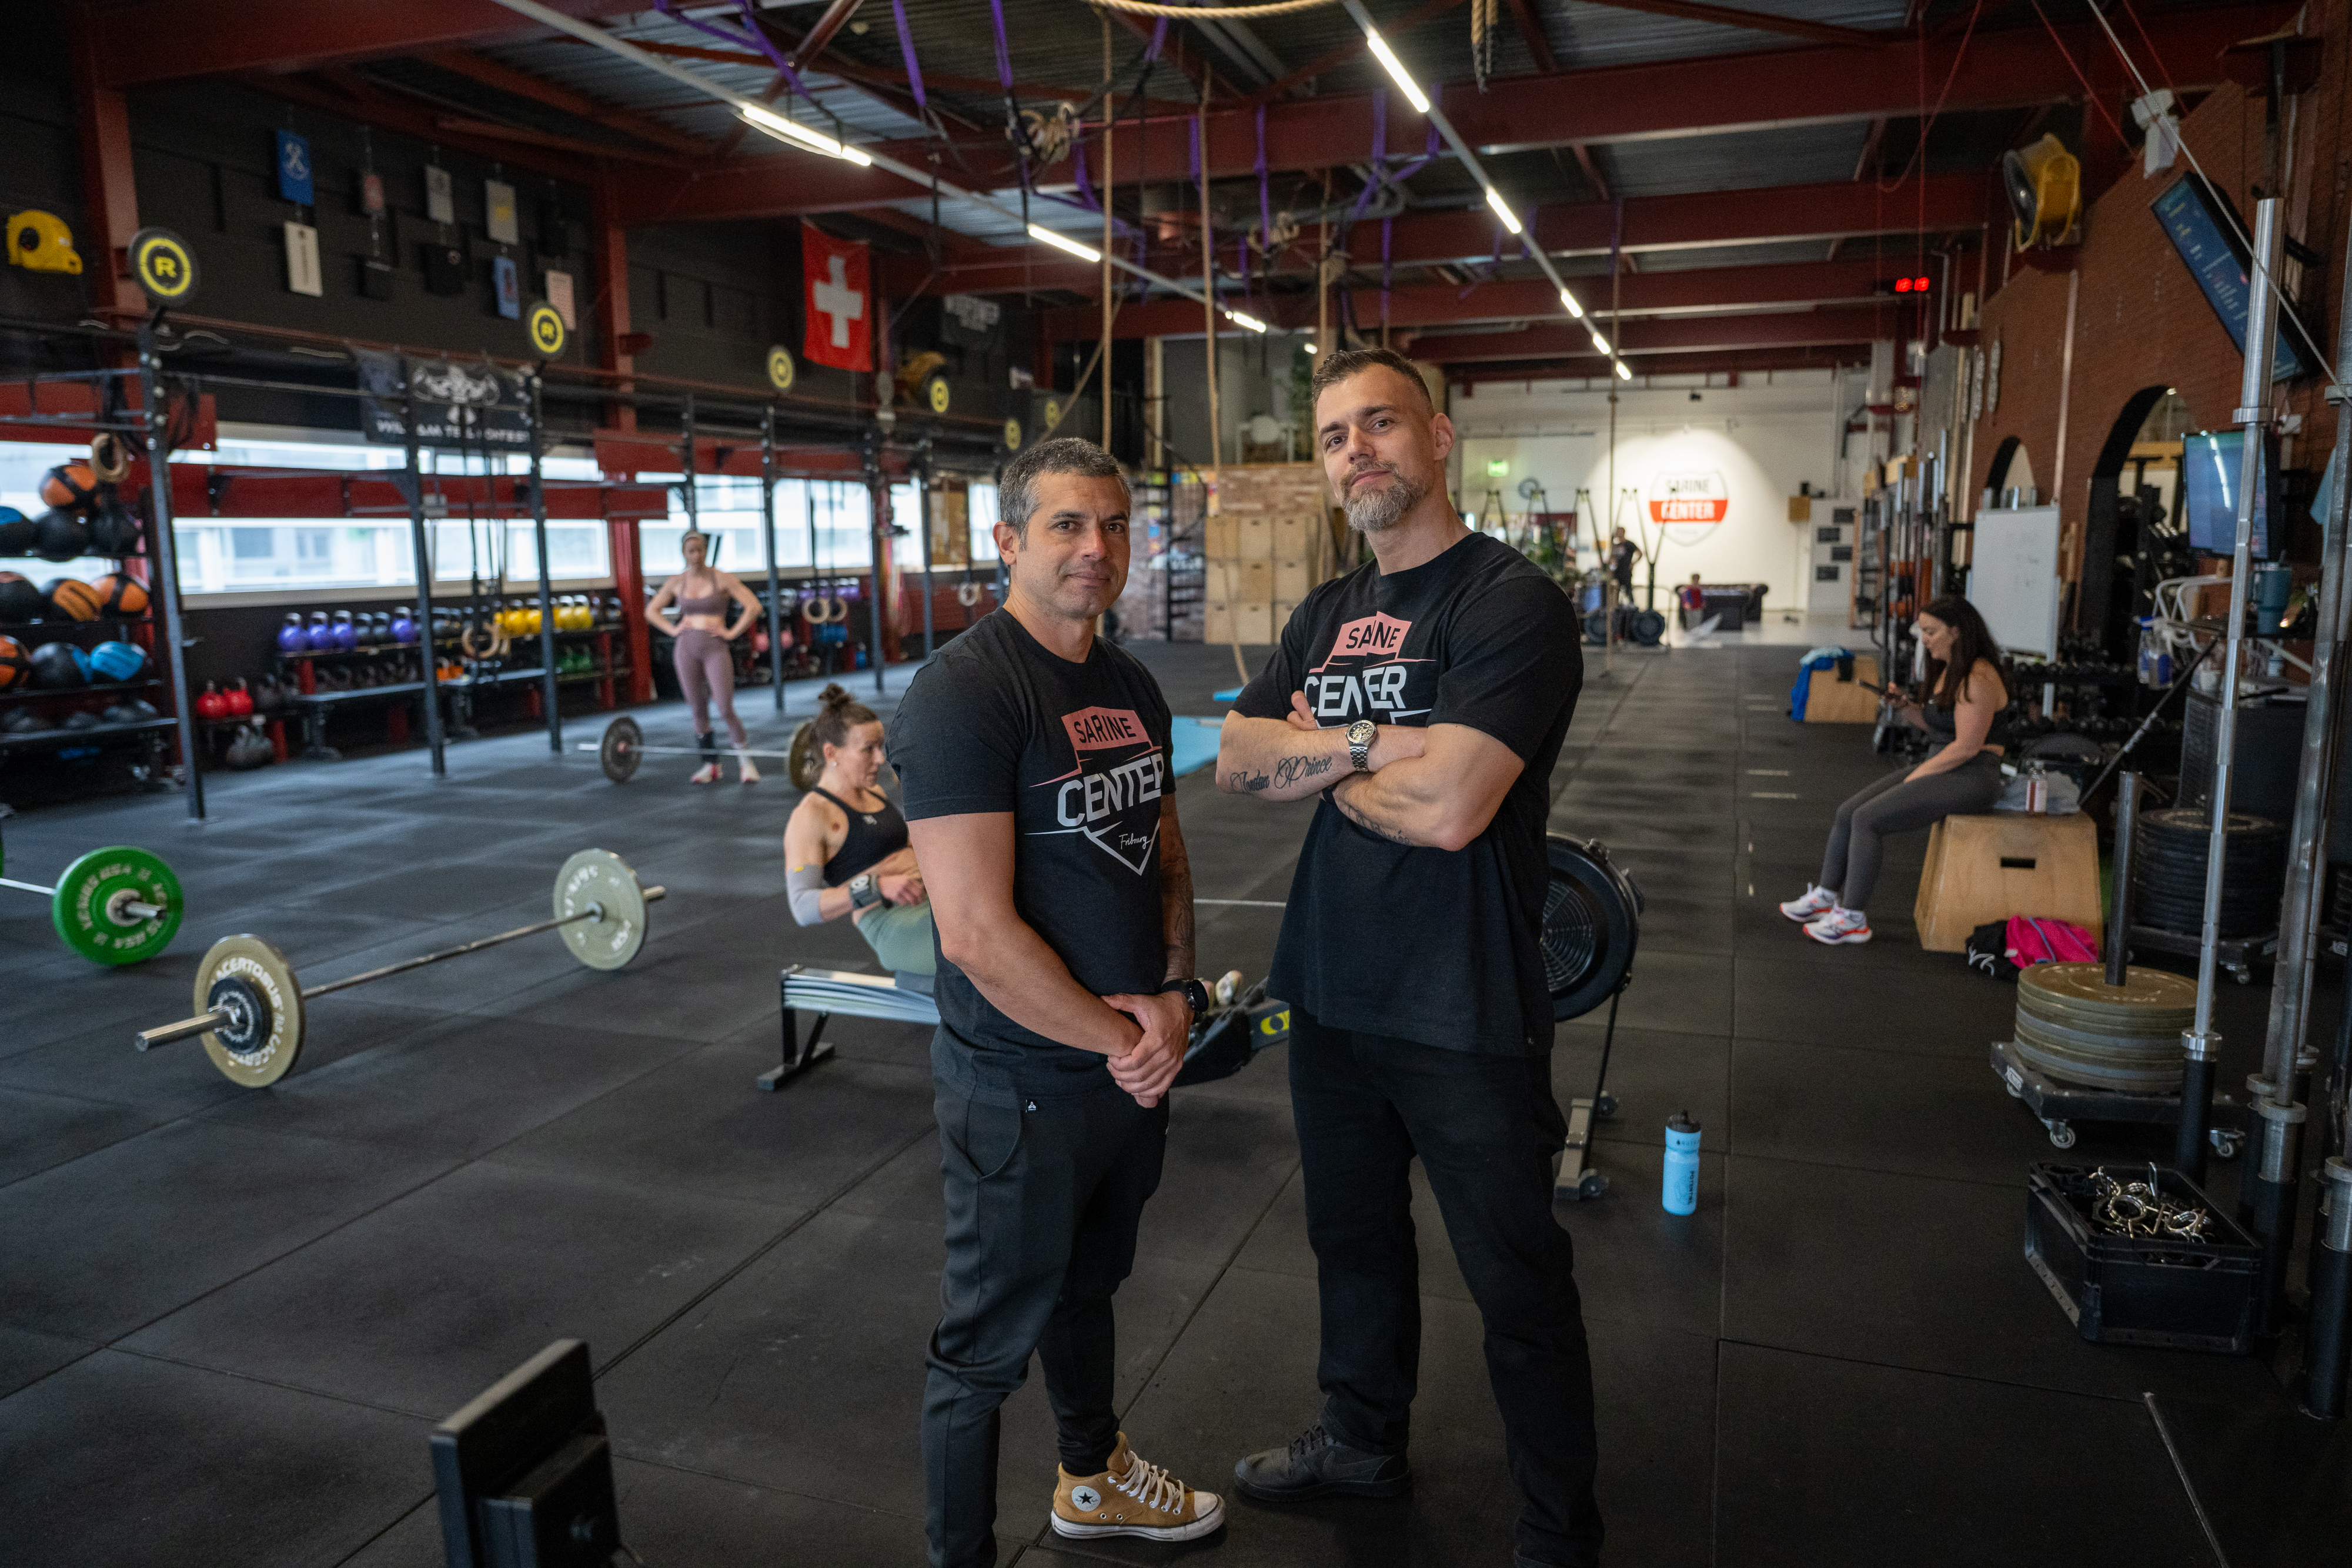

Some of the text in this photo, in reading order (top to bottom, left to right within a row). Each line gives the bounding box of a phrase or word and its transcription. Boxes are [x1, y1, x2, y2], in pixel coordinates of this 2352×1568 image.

[155, 256, 176, 278] R
[1666, 479, 1710, 494] SARINE
[1661, 501, 1715, 520] CENTER
[1074, 714, 1137, 743] SARINE
[1230, 756, 1332, 793] Jordan Prince
[1058, 753, 1164, 827] CENTER
[1119, 833, 1149, 850] Fribourg
[211, 957, 284, 1012] ACERTOSUS
